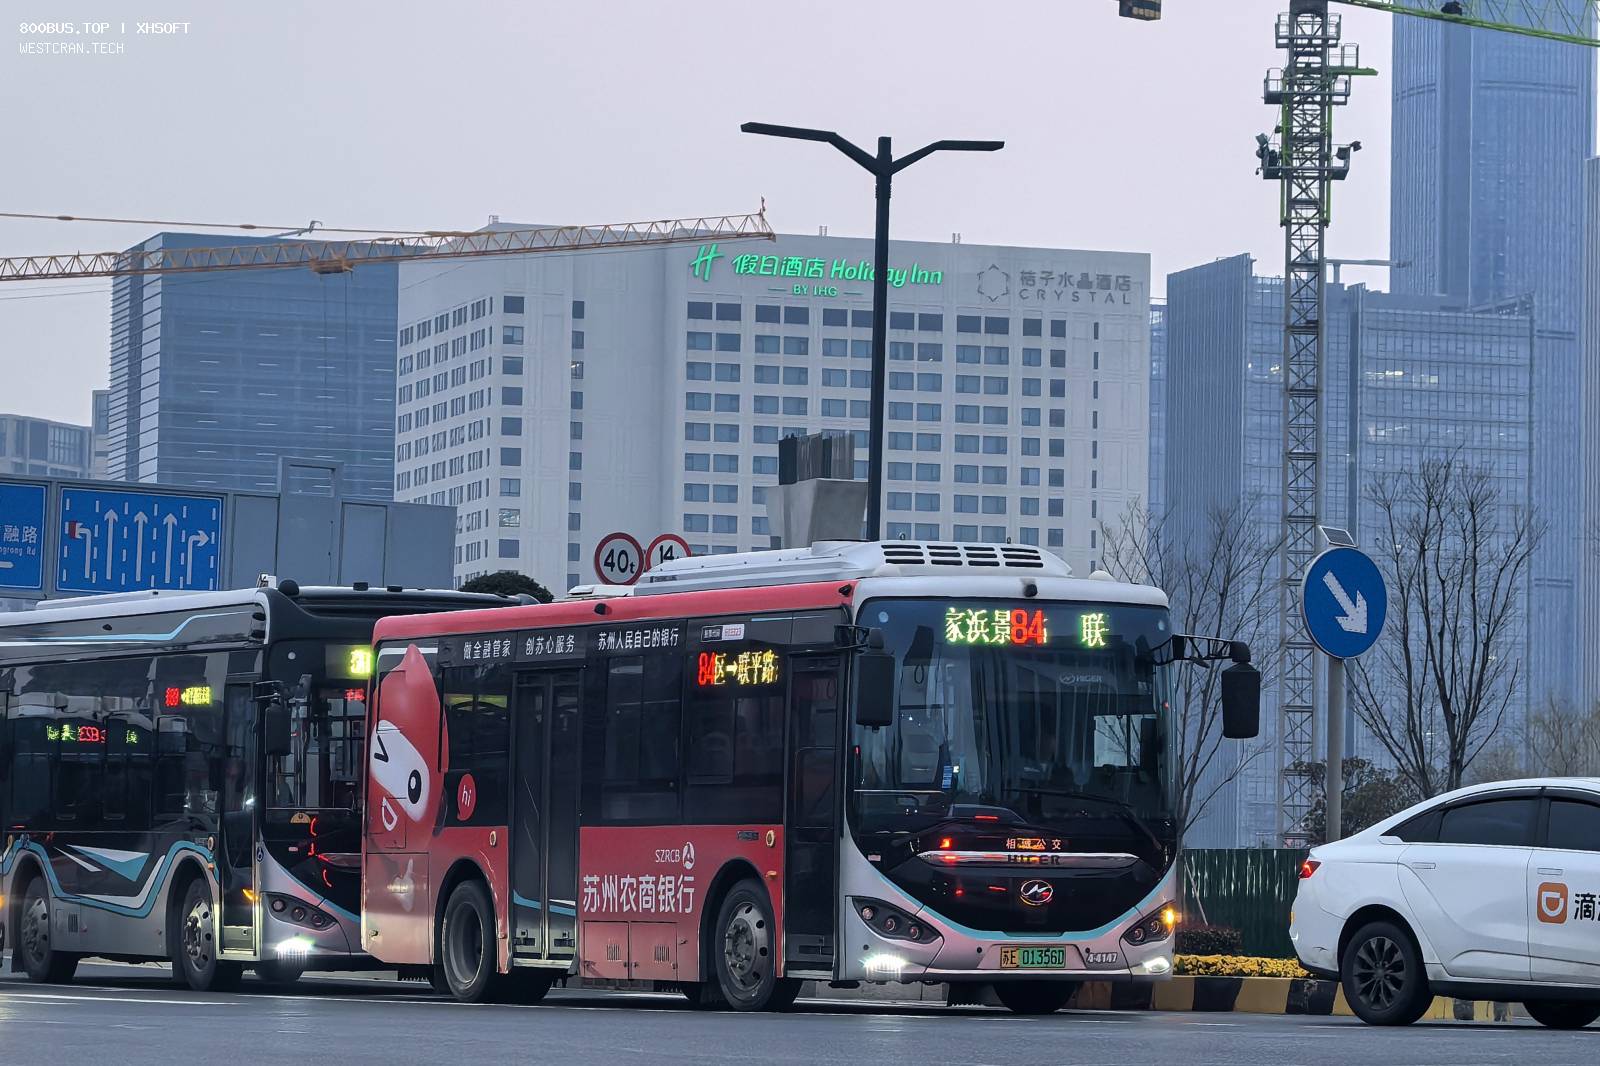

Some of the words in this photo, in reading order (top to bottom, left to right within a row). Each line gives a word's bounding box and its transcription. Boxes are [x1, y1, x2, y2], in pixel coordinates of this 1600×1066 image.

[732, 254, 826, 279] 假日酒店
[831, 258, 908, 288] Holiay
[911, 262, 944, 285] Inn
[792, 284, 809, 296] BY
[814, 286, 838, 297] IHG
[1019, 288, 1131, 305] CRYSTAL
[0, 525, 37, 544] 融路
[659, 544, 680, 564] 14
[1009, 608, 1045, 645] 84
[1080, 612, 1110, 647] 联
[463, 638, 511, 660] 做金融管家
[525, 634, 575, 656] 创苏心服务
[598, 628, 679, 651] 苏州人民自己的银行
[698, 651, 716, 686] 84
[461, 785, 472, 807] hi
[655, 849, 680, 863] SZRCB
[583, 874, 695, 913] 苏州农商银行
[1573, 892, 1600, 921] 滴
